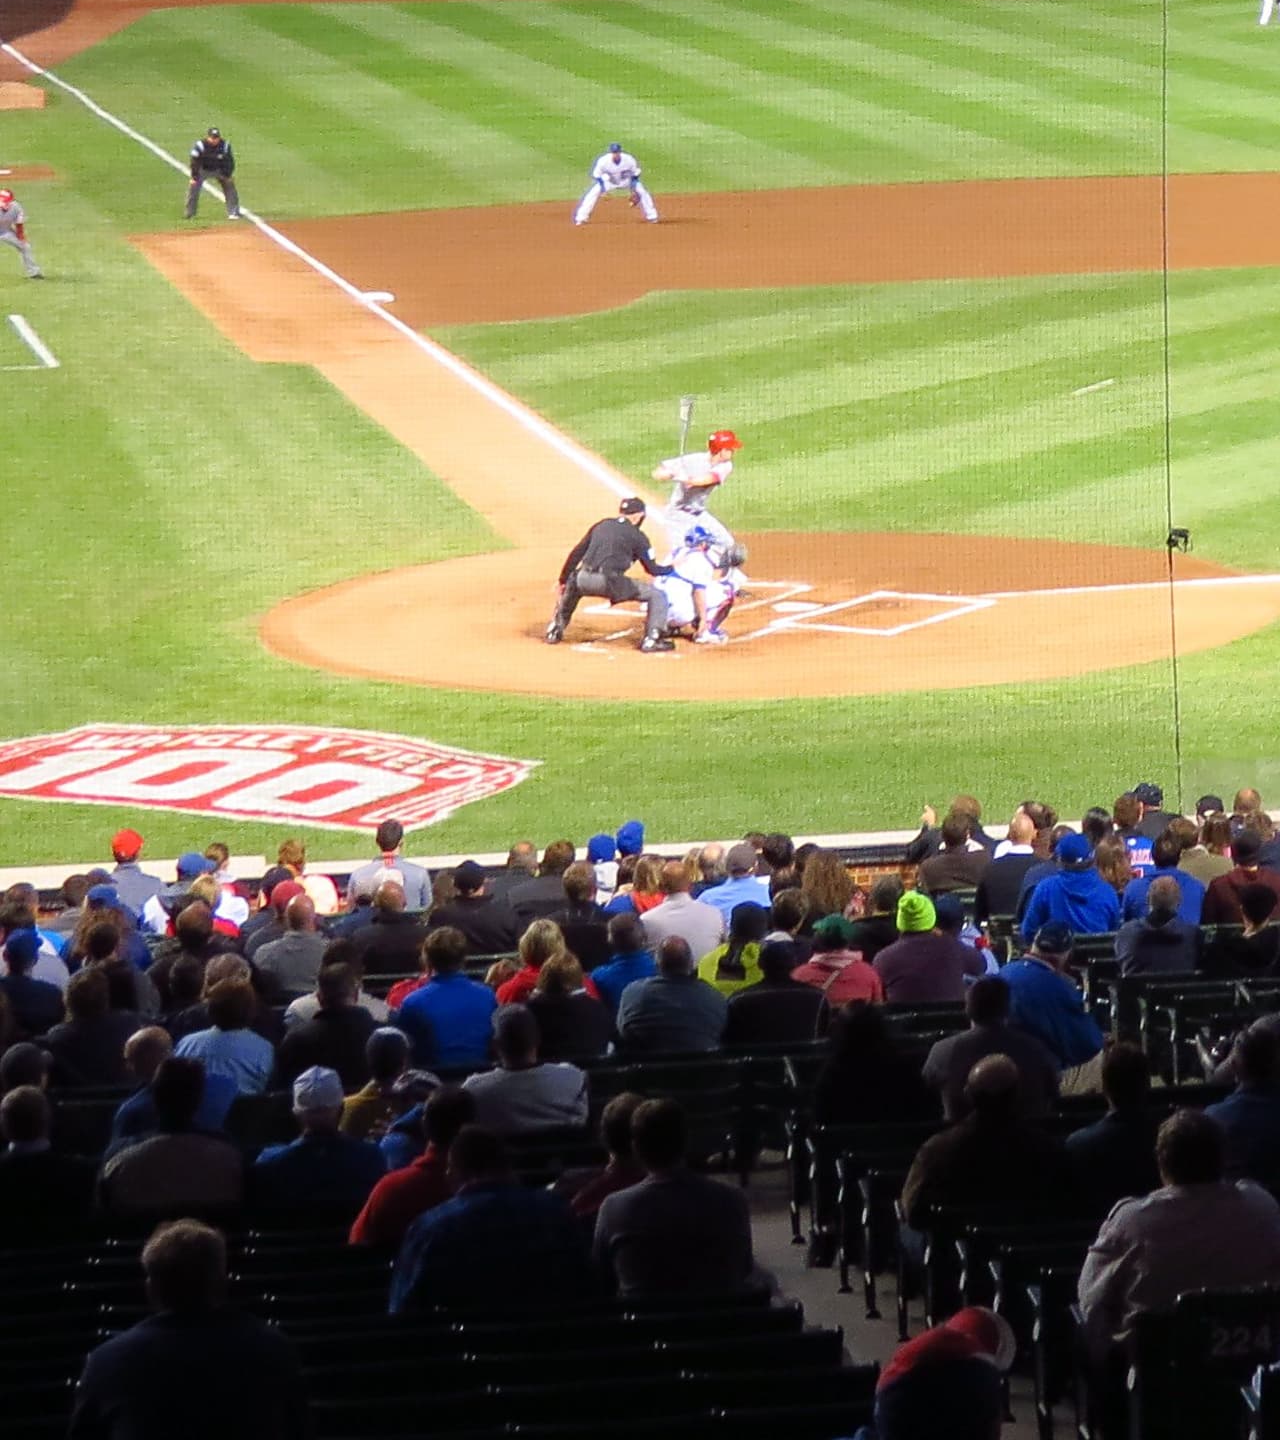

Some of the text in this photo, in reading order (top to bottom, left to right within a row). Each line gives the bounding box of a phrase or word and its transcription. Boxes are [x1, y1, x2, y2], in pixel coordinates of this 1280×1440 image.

[69, 733, 485, 779] WRIGLEY FIELD
[0, 749, 425, 817] 100
[1212, 1325, 1272, 1356] 224
